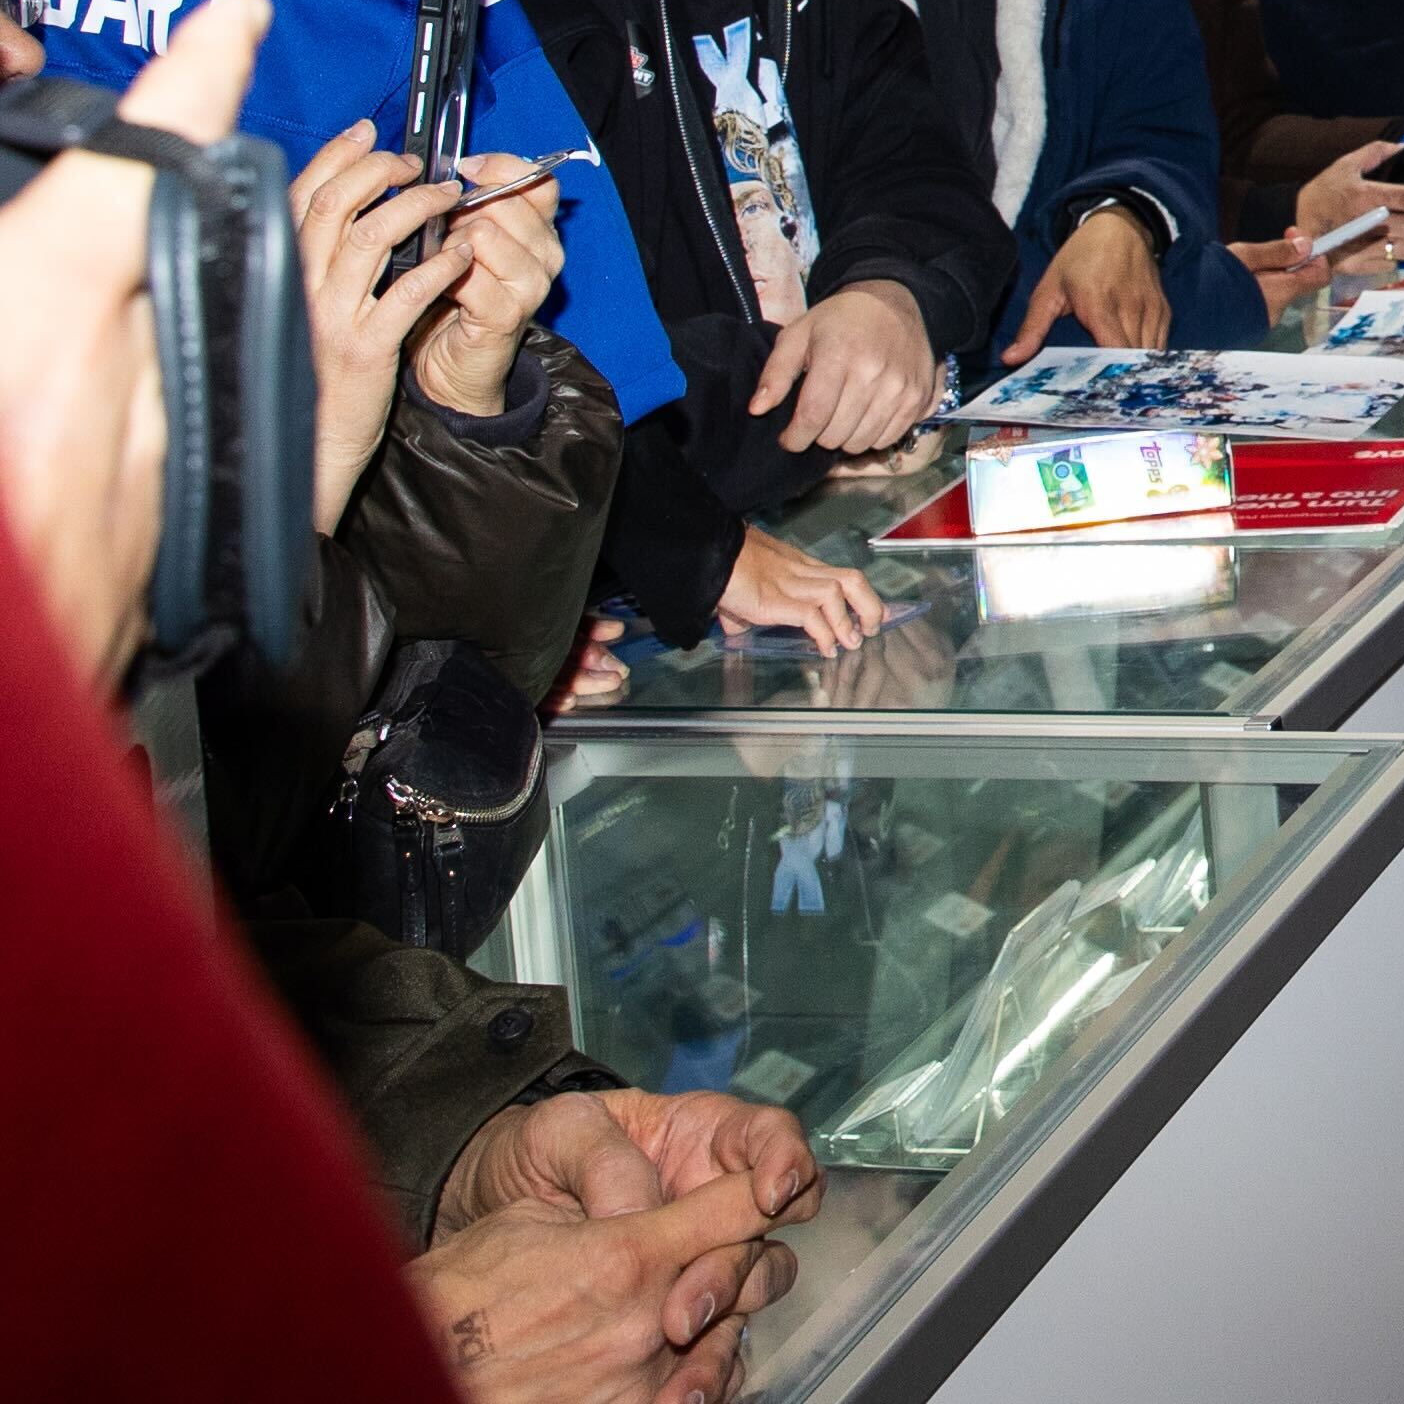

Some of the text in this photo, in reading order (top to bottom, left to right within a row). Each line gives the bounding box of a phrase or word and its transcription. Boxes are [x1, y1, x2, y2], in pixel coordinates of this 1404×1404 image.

[1302, 491, 1324, 500] a
[1334, 489, 1400, 500] into
[1308, 498, 1387, 509] Turn
